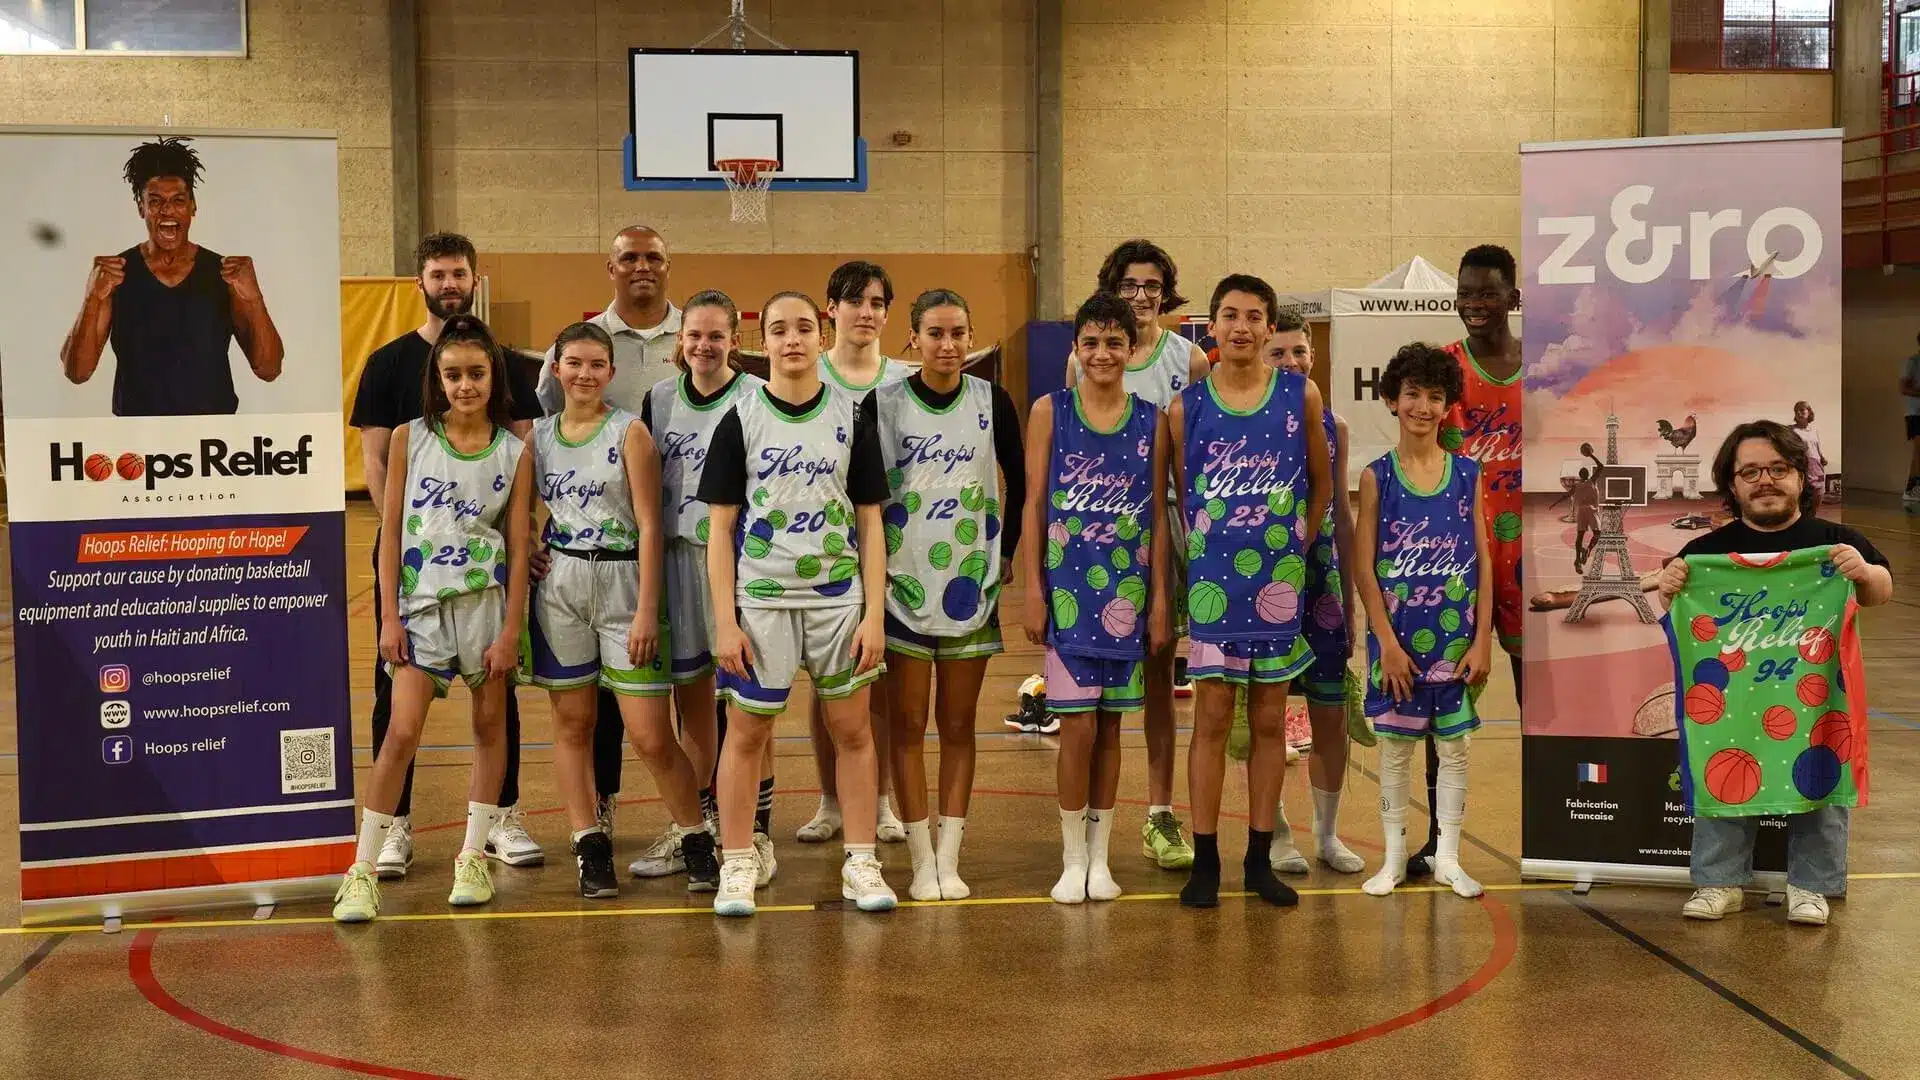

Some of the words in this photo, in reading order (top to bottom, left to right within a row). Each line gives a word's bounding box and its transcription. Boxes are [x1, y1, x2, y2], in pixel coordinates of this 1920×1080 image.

[50, 440, 194, 490] Hoops
[199, 434, 313, 478] Relief
[757, 445, 837, 487] Hoops
[896, 433, 976, 474] Hoops
[1202, 439, 1282, 480] Hoops
[541, 470, 607, 508] Hoops
[1059, 453, 1137, 498] Hoops
[1203, 462, 1302, 505] Relief
[122, 492, 238, 503] Association
[411, 476, 487, 521] Hoops
[926, 498, 959, 520] 12
[1061, 481, 1153, 526] Relief
[786, 510, 827, 534] 20
[1226, 505, 1271, 528] 23
[85, 535, 126, 556] Hoops
[129, 532, 168, 553] Relief:
[171, 532, 225, 555] Hooping
[228, 530, 247, 550] for
[249, 528, 287, 551] Hope!
[1080, 522, 1118, 544] 42
[1382, 520, 1461, 561] Hoops
[431, 545, 470, 567] 23
[1386, 544, 1478, 587] Relief
[48, 569, 101, 592] Support
[103, 569, 127, 586] our
[128, 567, 167, 585] cause
[167, 566, 184, 588] by
[186, 561, 244, 584] donating
[247, 560, 311, 579] basketball
[19, 602, 91, 625] equipment
[93, 598, 119, 618] and
[121, 594, 198, 616] educational
[199, 592, 251, 617] supplies
[253, 594, 267, 609] to
[268, 591, 329, 612] empower
[1406, 586, 1446, 608] 35
[1712, 589, 1809, 633] Hoops
[93, 630, 132, 654] youth
[134, 629, 148, 647] in
[150, 627, 182, 646] Haiti
[182, 625, 208, 645] and
[209, 624, 250, 643] Africa.
[1722, 613, 1839, 657] Relief
[142, 666, 232, 686] @hoopsrelief
[1752, 656, 1799, 683] 94
[143, 699, 291, 720] www.hoopsrelief.com
[145, 741, 189, 756] Hoops
[191, 737, 227, 752] relief
[1566, 798, 1619, 810] Fabrication
[1570, 810, 1614, 821] francaise
